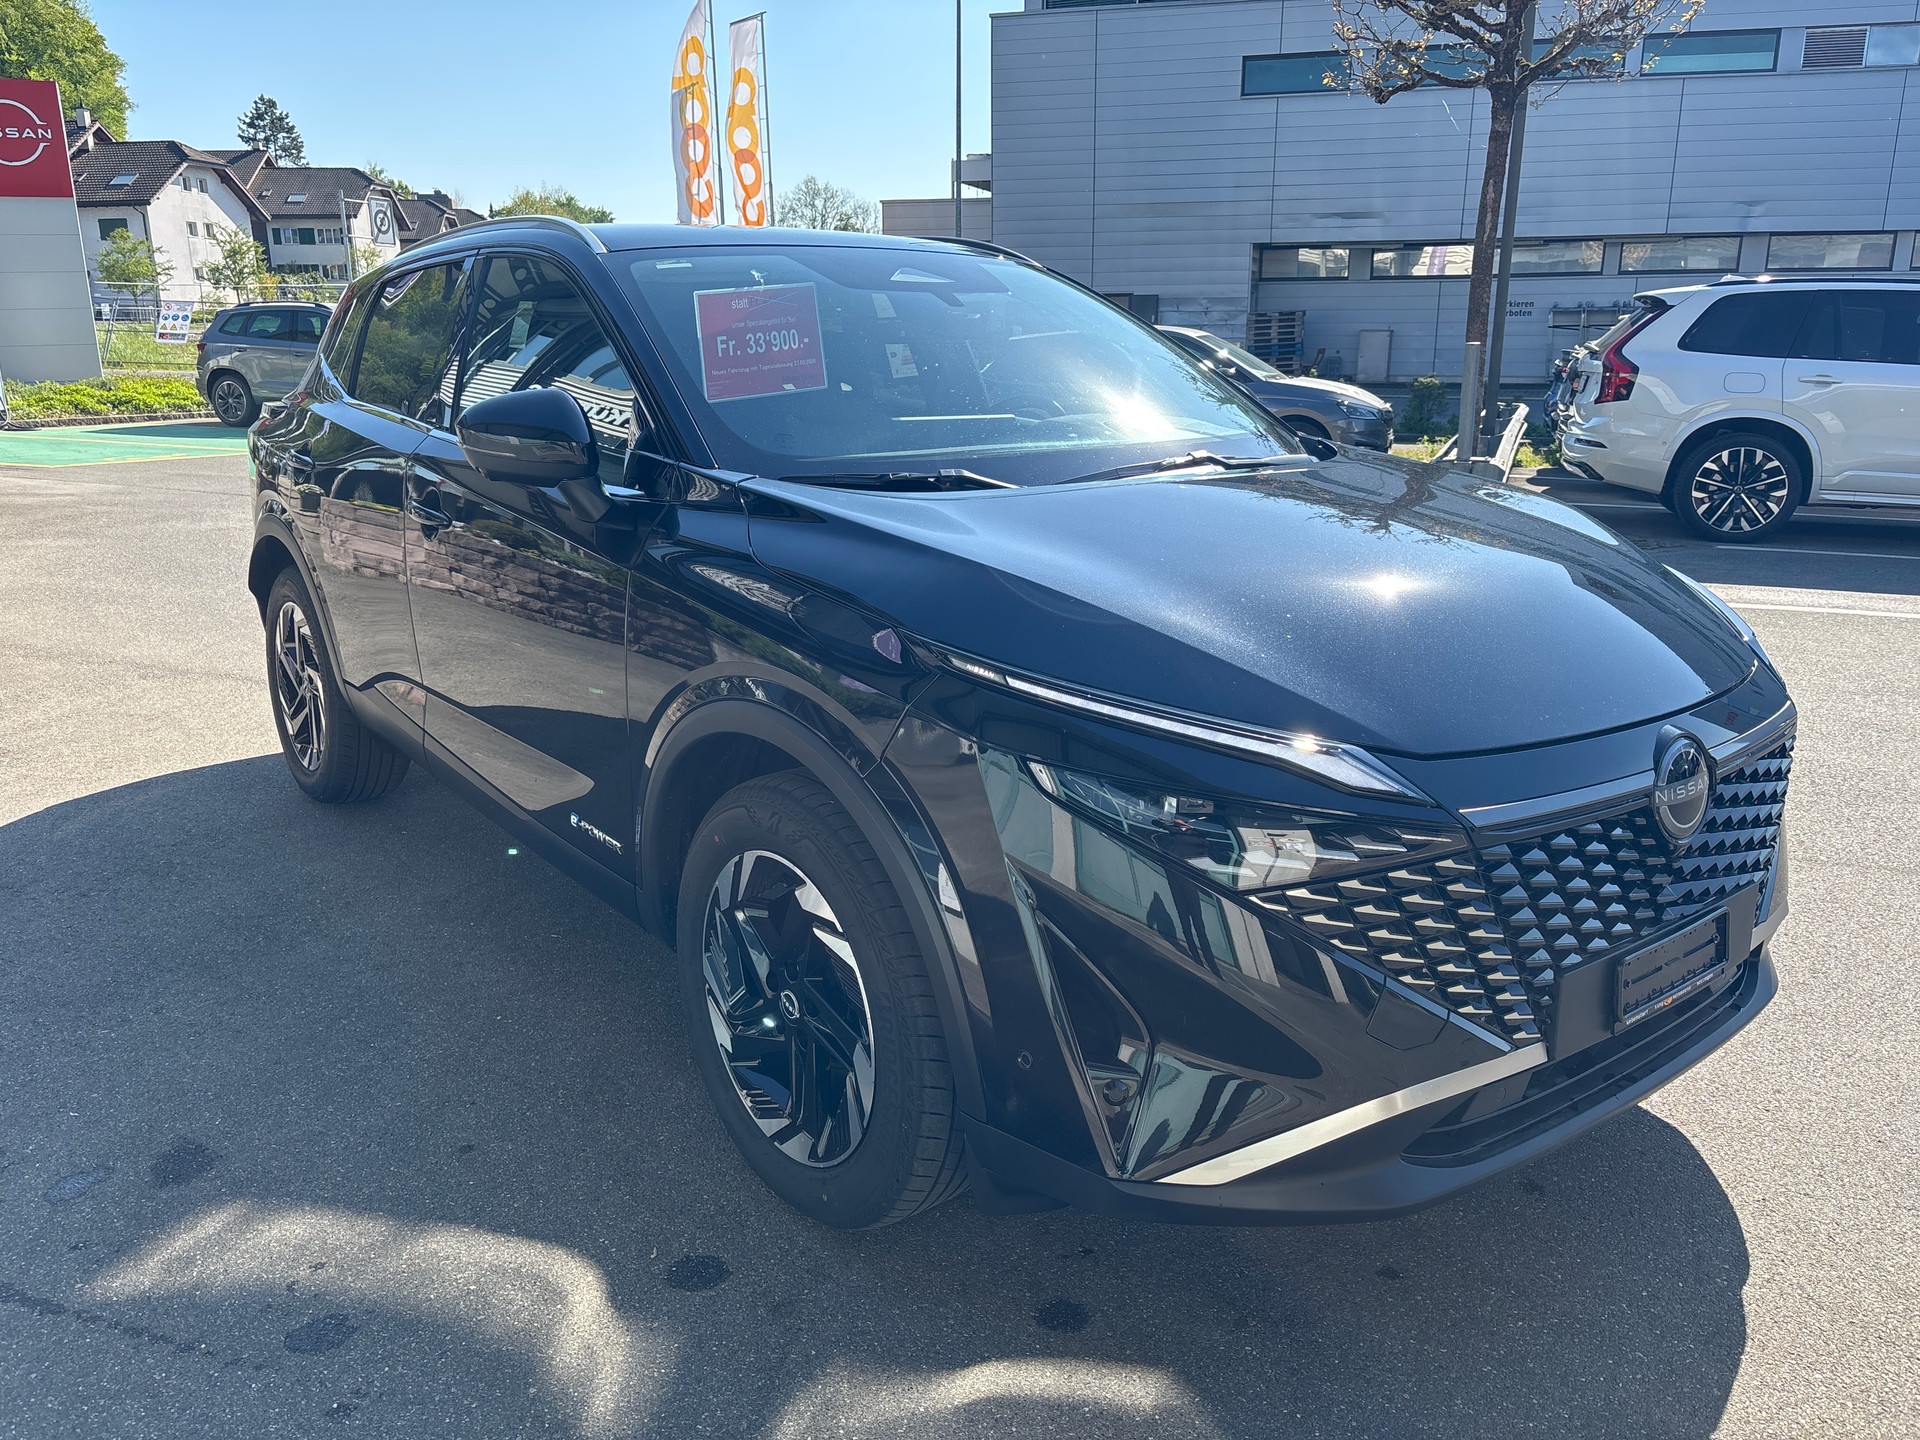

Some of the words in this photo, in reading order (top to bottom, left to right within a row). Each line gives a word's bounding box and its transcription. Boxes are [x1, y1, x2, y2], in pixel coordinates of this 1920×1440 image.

[0, 127, 52, 139] SAN
[671, 36, 714, 218] coop
[728, 67, 765, 226] coop
[731, 298, 749, 309] statt
[716, 335, 741, 357] Fr.
[966, 663, 995, 678] NISSAN
